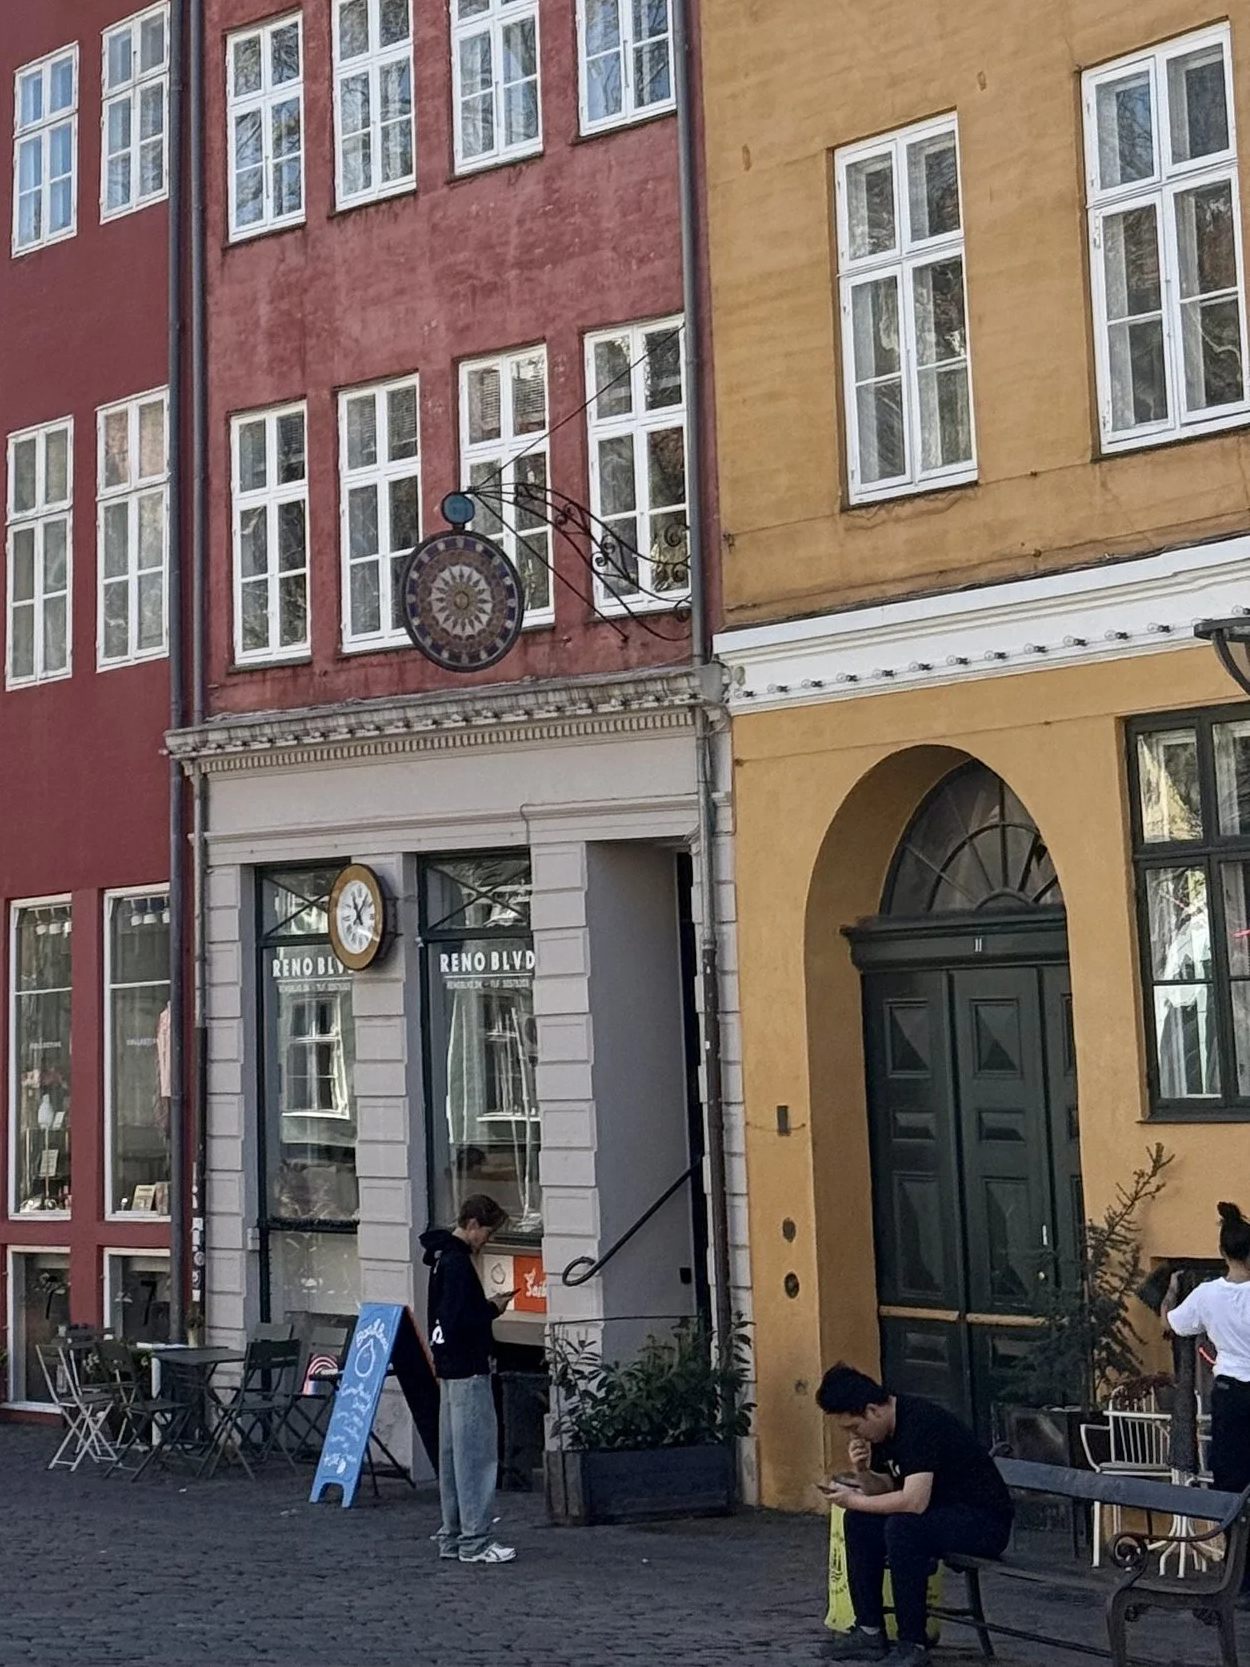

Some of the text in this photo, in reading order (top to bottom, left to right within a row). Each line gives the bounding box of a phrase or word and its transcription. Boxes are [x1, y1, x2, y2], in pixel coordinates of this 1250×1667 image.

[272, 956, 354, 977] RENO BLV
[440, 950, 535, 973] RENO BLVD
